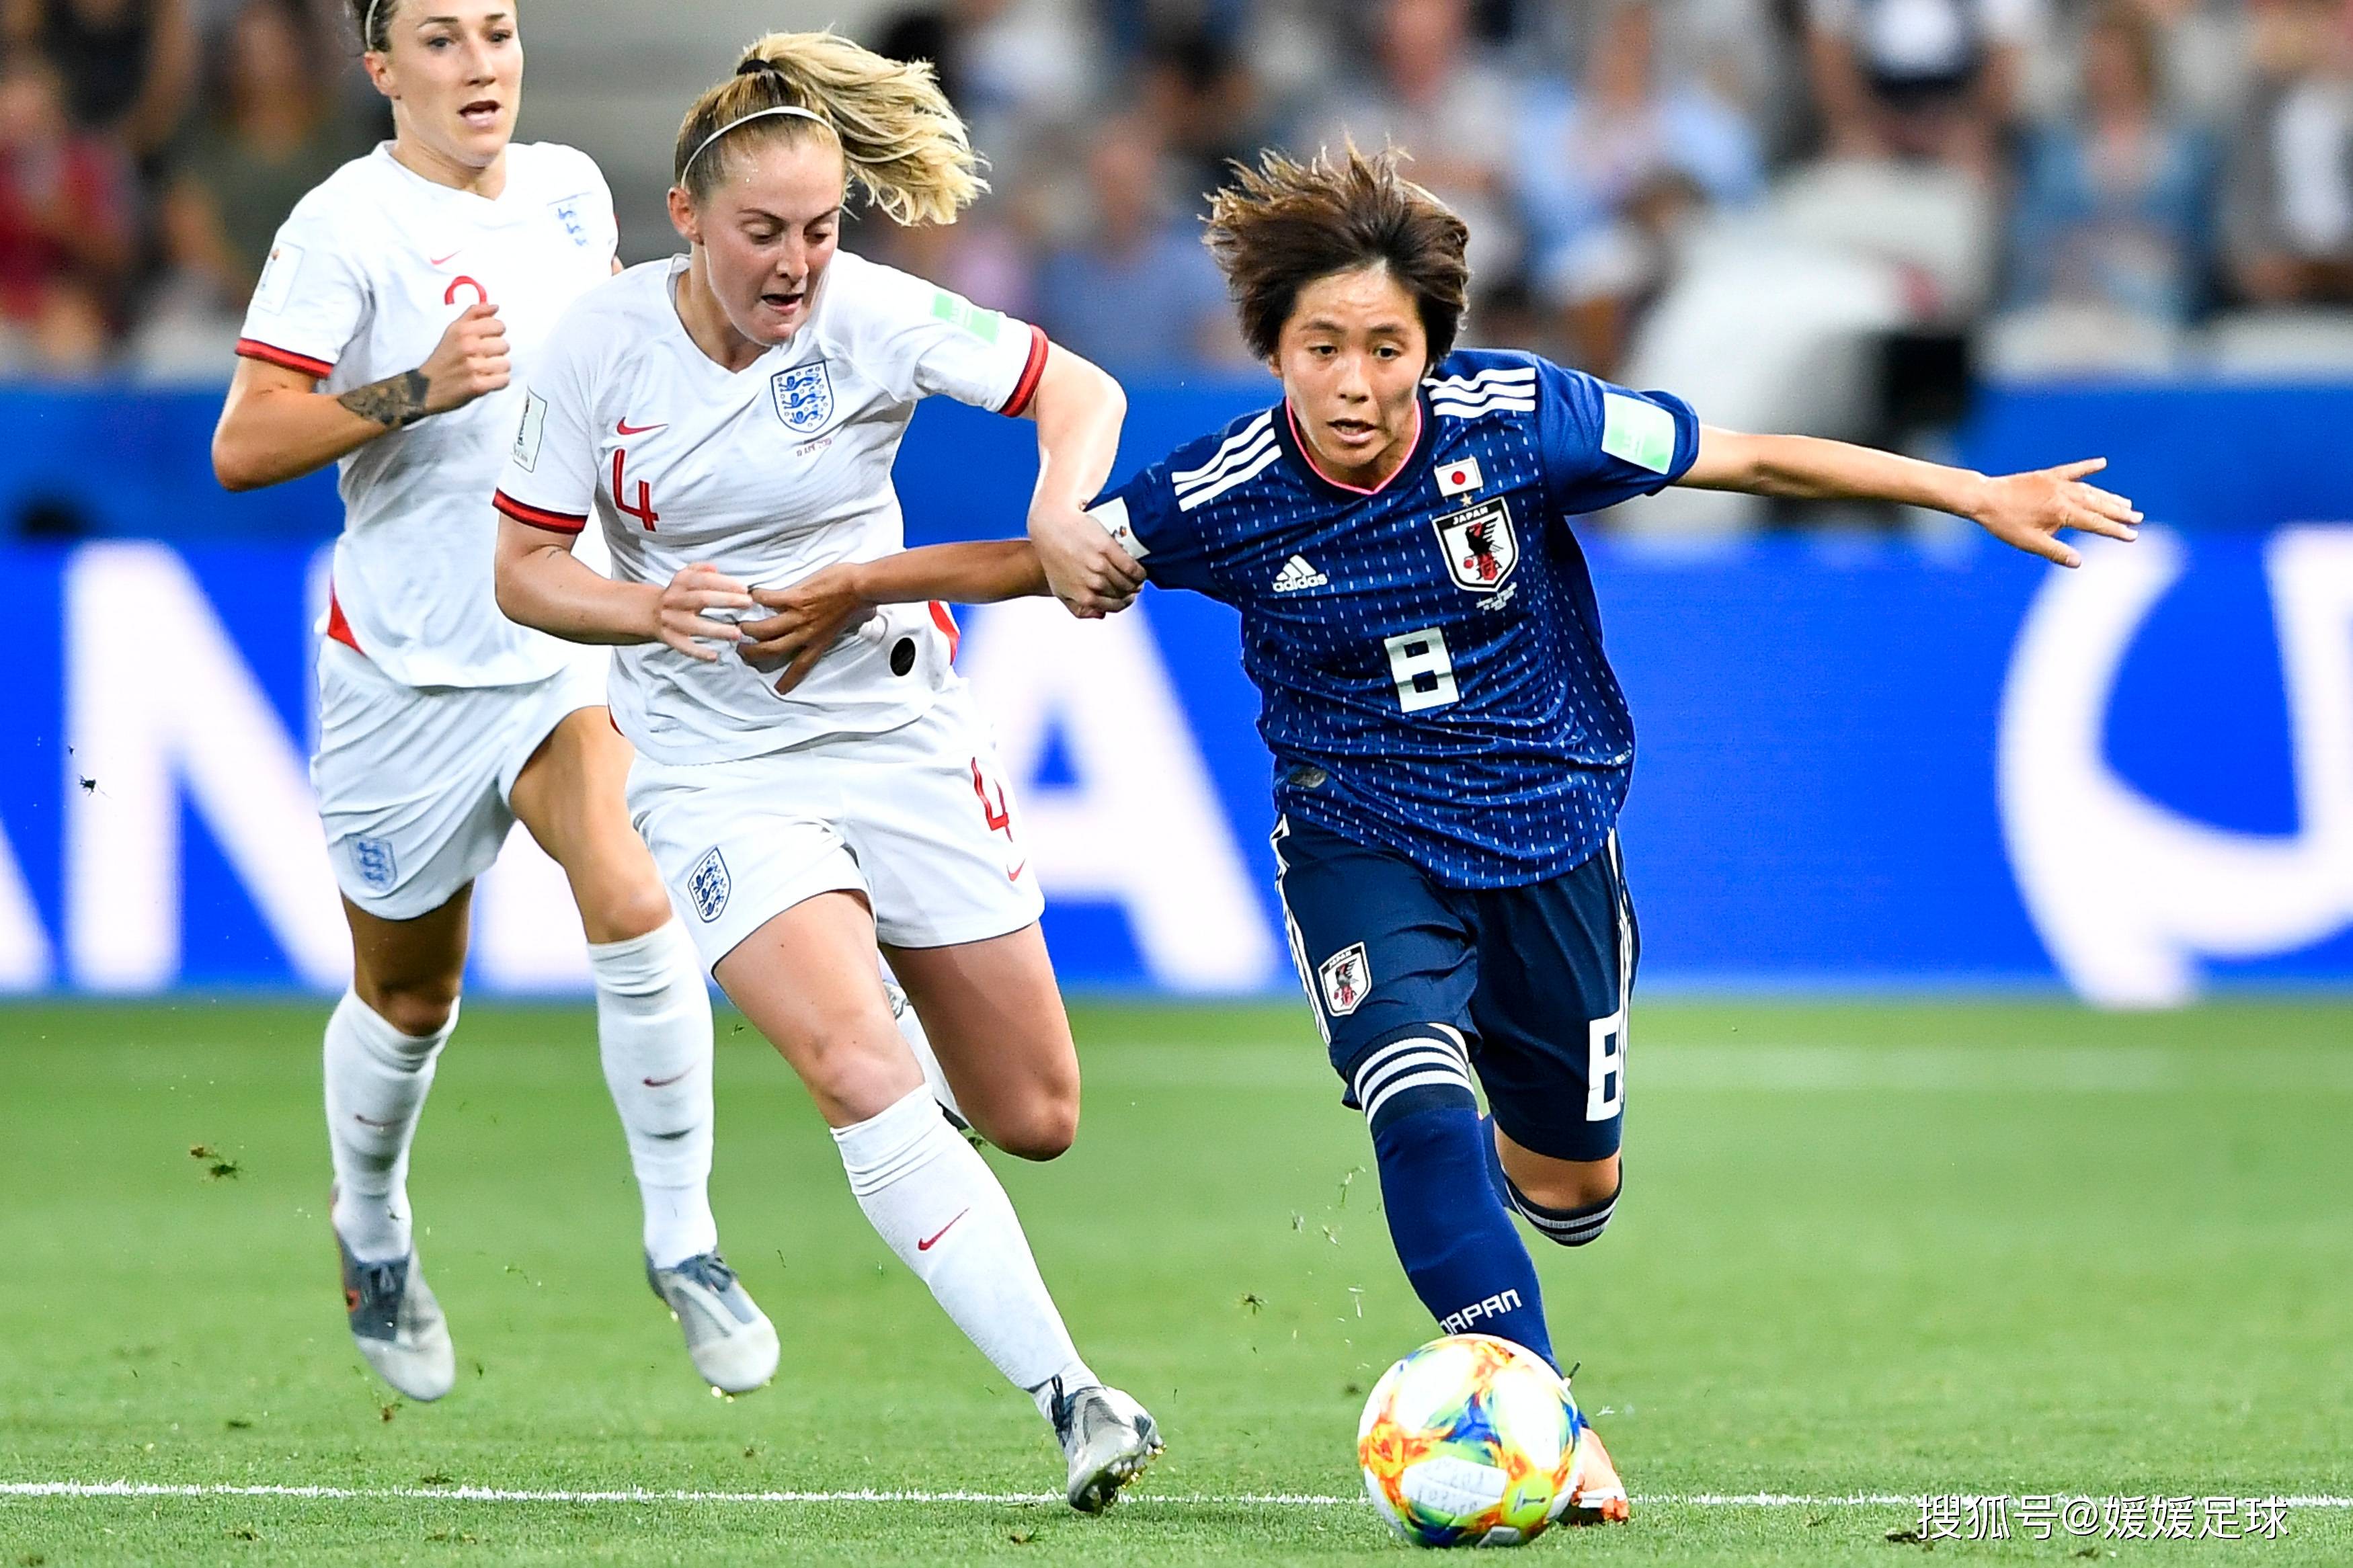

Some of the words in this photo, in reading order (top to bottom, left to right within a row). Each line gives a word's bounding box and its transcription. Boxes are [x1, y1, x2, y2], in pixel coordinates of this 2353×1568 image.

[612, 448, 660, 532] 4
[1453, 506, 1488, 526] JAPAN
[1273, 573, 1328, 592] adidas
[1384, 626, 1460, 713] 8
[971, 756, 1014, 843] 4
[1586, 1011, 1622, 1122] 8
[1439, 1288, 1523, 1337] JAPAN
